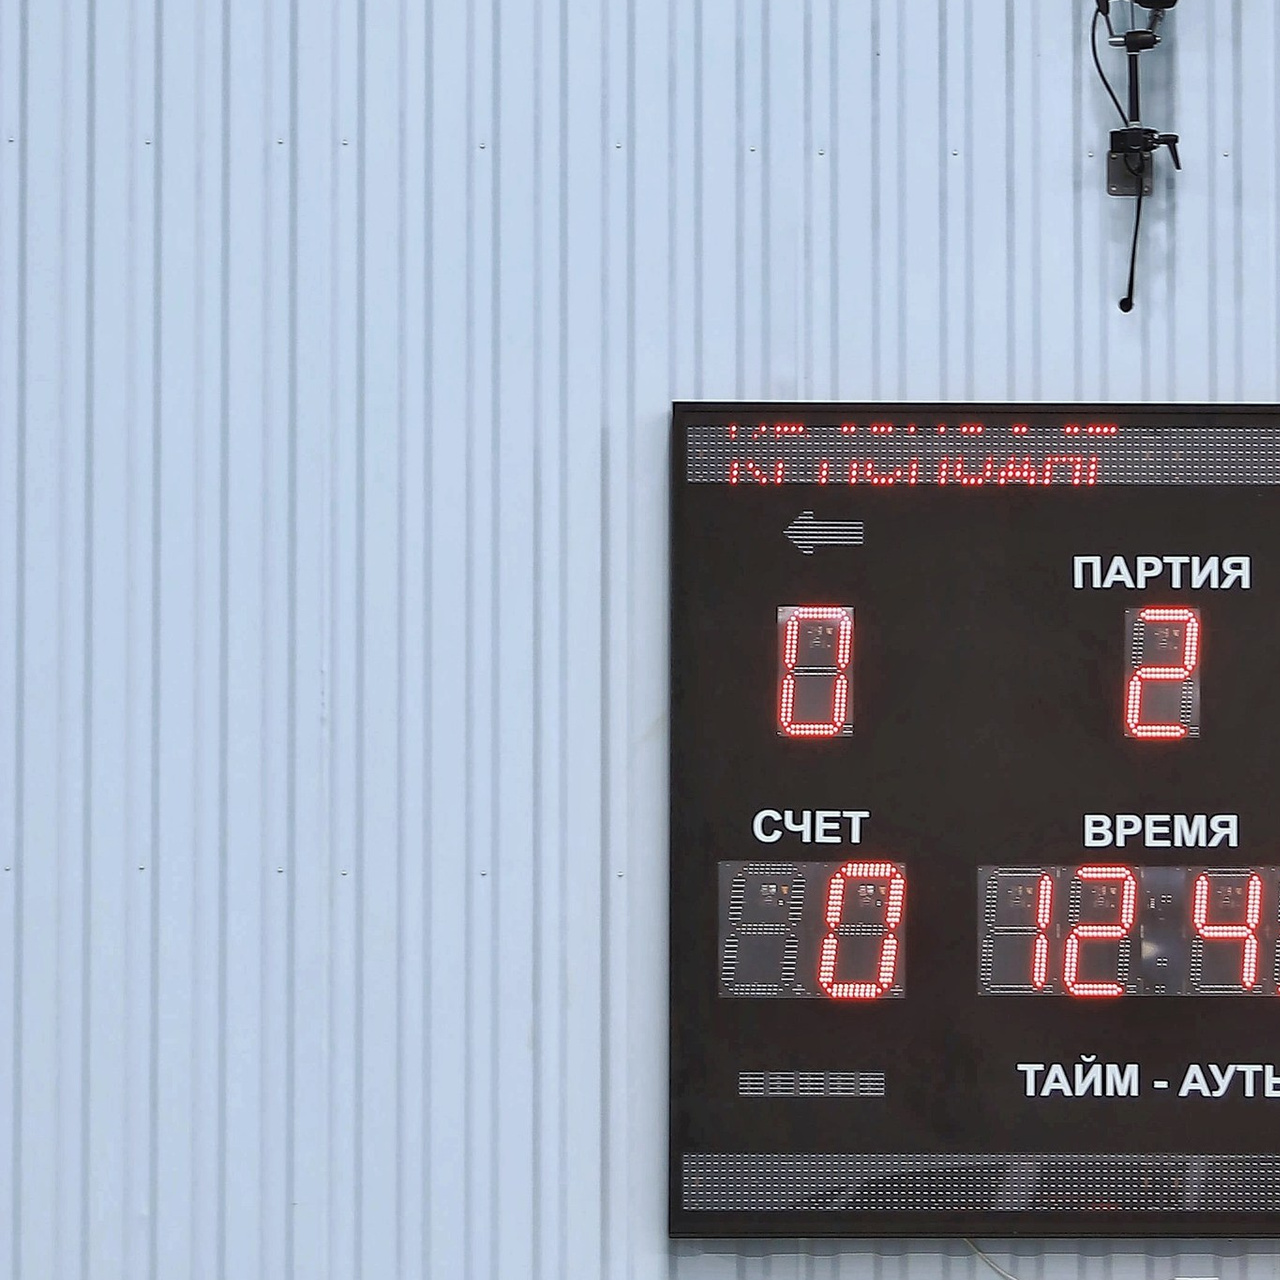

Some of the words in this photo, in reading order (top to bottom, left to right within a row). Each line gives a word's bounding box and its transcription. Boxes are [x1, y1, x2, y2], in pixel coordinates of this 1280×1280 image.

[1073, 555, 1251, 589] ПАРТИЯ
[780, 606, 854, 737] 0
[1124, 608, 1200, 738] 2
[753, 809, 870, 844] СЧЕТ
[1084, 814, 1238, 847] ВРЕМЯ
[818, 862, 905, 999] 0
[1016, 1054, 1139, 1097] ТАЙМ
